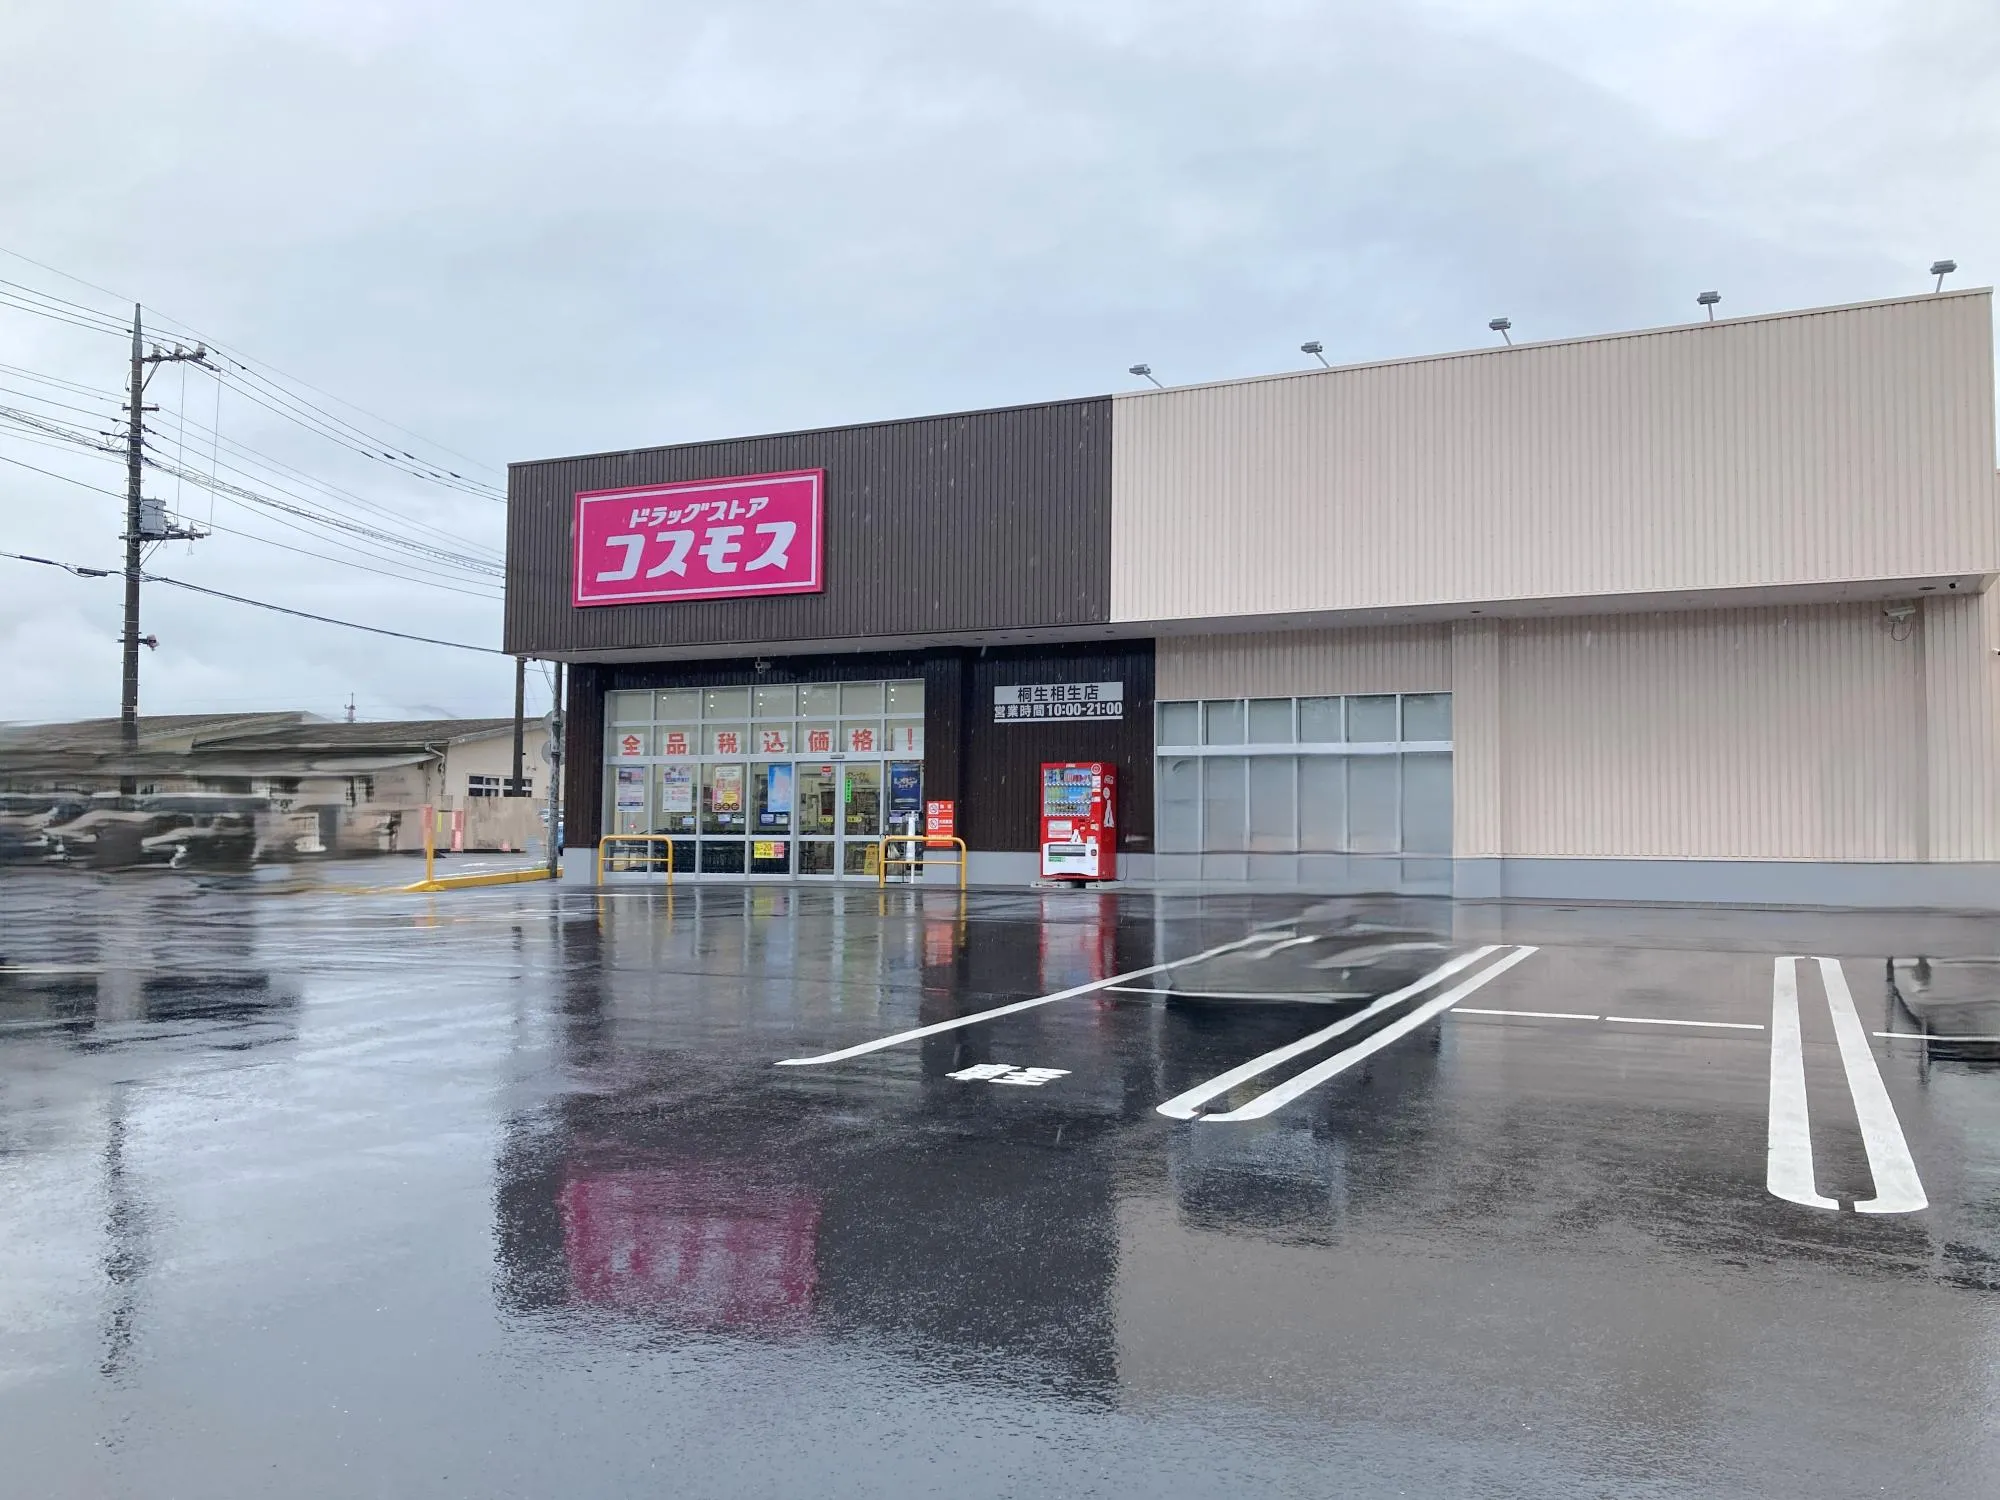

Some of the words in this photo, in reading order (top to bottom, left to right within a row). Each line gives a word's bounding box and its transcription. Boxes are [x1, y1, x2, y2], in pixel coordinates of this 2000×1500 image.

[629, 496, 769, 528] ドラッグストア
[595, 521, 797, 582] コスモス
[1018, 684, 1099, 702] 桐生相生店
